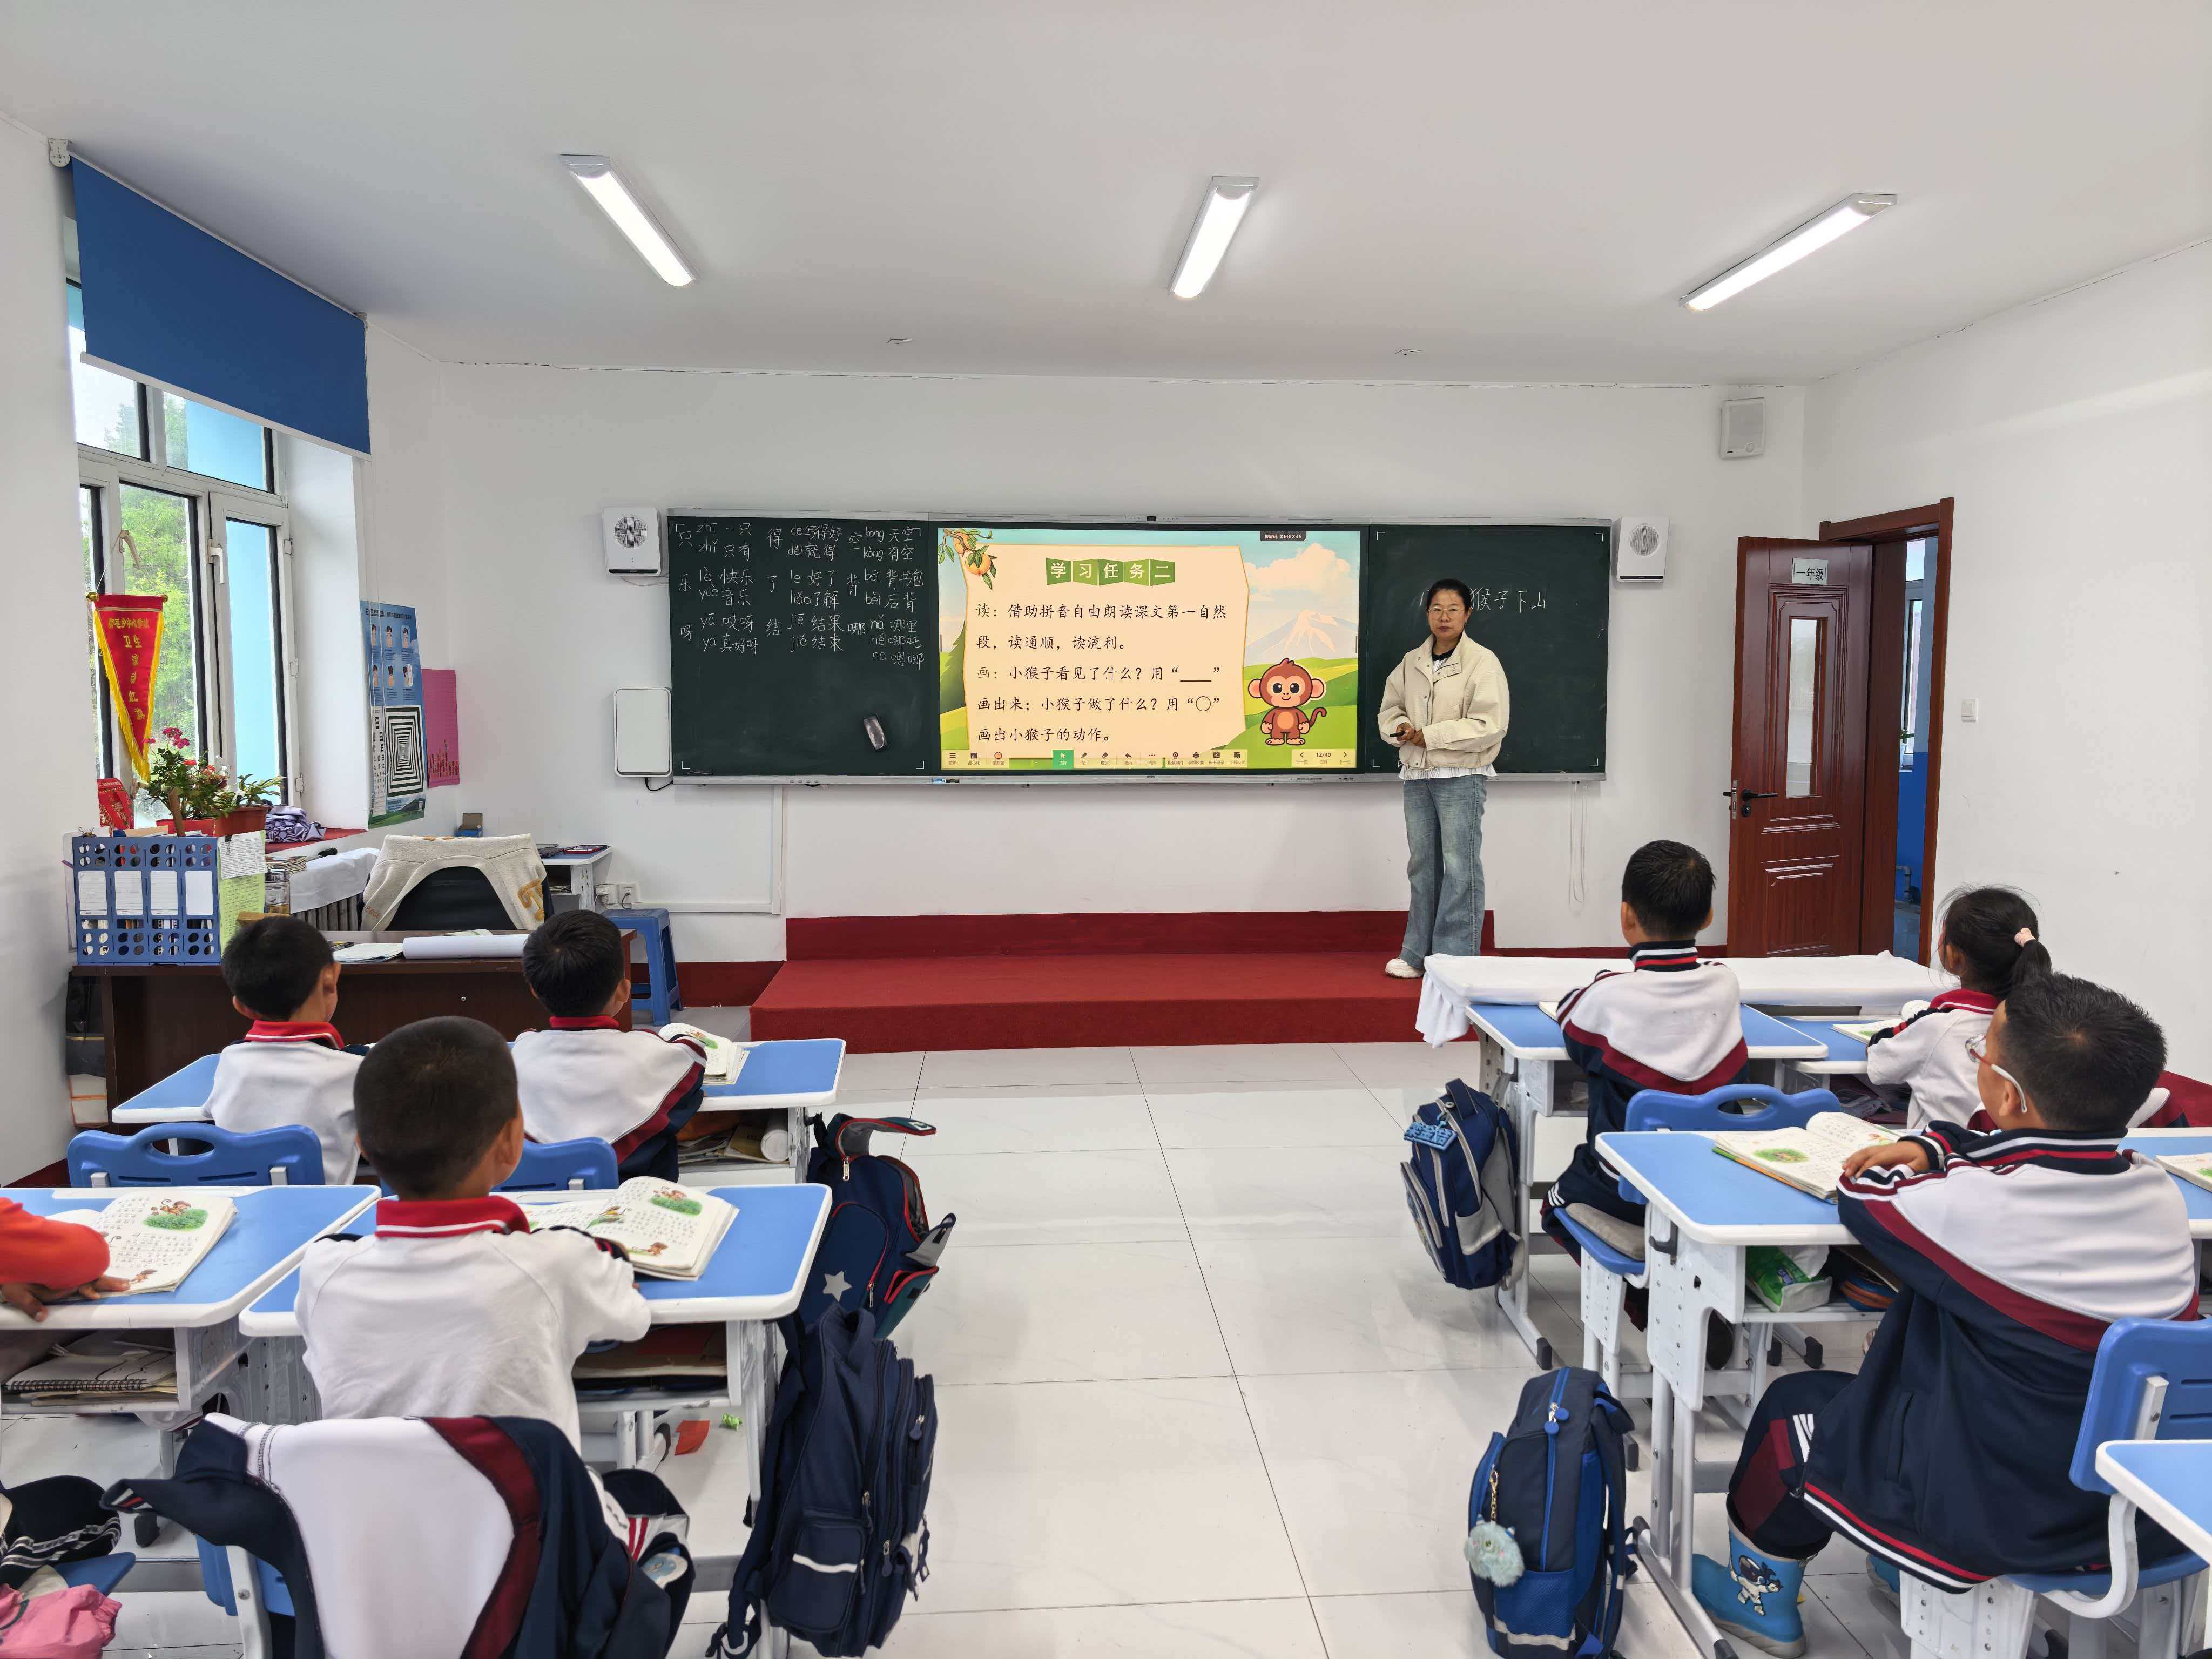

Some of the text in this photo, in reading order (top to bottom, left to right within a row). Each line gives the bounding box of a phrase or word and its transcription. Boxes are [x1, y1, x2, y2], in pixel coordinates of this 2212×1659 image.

[725, 523, 752, 536] 一只
[766, 528, 784, 549] 得
[804, 524, 842, 542] 写得好
[889, 526, 914, 543] 天空
[678, 531, 693, 547] 只
[848, 532, 864, 550] 空
[724, 542, 750, 562] 只有
[804, 542, 837, 561] 就得
[888, 544, 914, 562] 有空
[720, 568, 754, 585] 快乐
[806, 569, 835, 587] 好了
[886, 569, 924, 590] 背书包
[1051, 562, 1170, 579] 学习任务二
[1796, 567, 1824, 581] 一年级
[679, 574, 692, 592] 乐
[767, 576, 777, 592] 了
[846, 573, 860, 597] 背
[721, 587, 751, 606] 音乐
[812, 590, 839, 611] 了解
[884, 592, 916, 613] 后背
[1470, 586, 1546, 613] 猴子下山
[766, 618, 780, 637] 结
[811, 615, 846, 632] 结果
[848, 622, 866, 641] 哪
[889, 619, 918, 636] 哪里
[680, 624, 693, 642] 呀
[812, 632, 844, 652] 结束
[720, 633, 759, 655] 真好呀
[888, 635, 922, 651] 哪吒
[977, 727, 1111, 743] 画出小猴子的动作。
